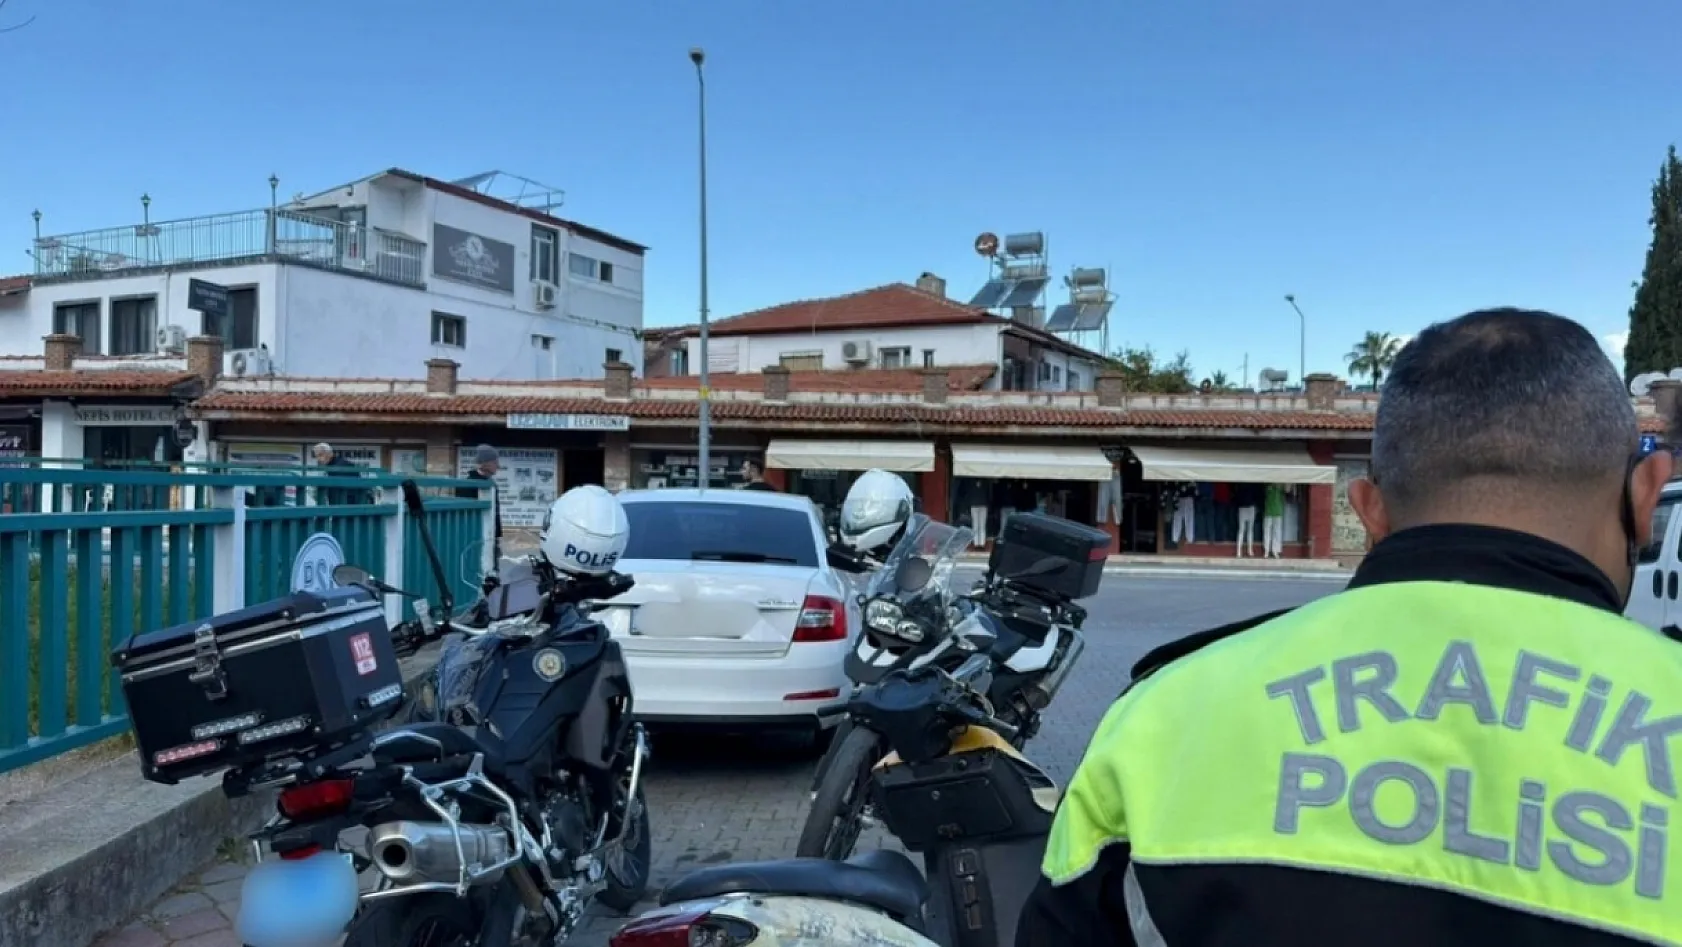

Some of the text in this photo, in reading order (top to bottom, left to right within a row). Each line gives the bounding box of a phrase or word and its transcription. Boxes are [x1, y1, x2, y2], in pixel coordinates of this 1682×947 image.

[112, 409, 156, 421] HOTEL
[1643, 437, 1652, 452] 2
[353, 638, 371, 658] 112
